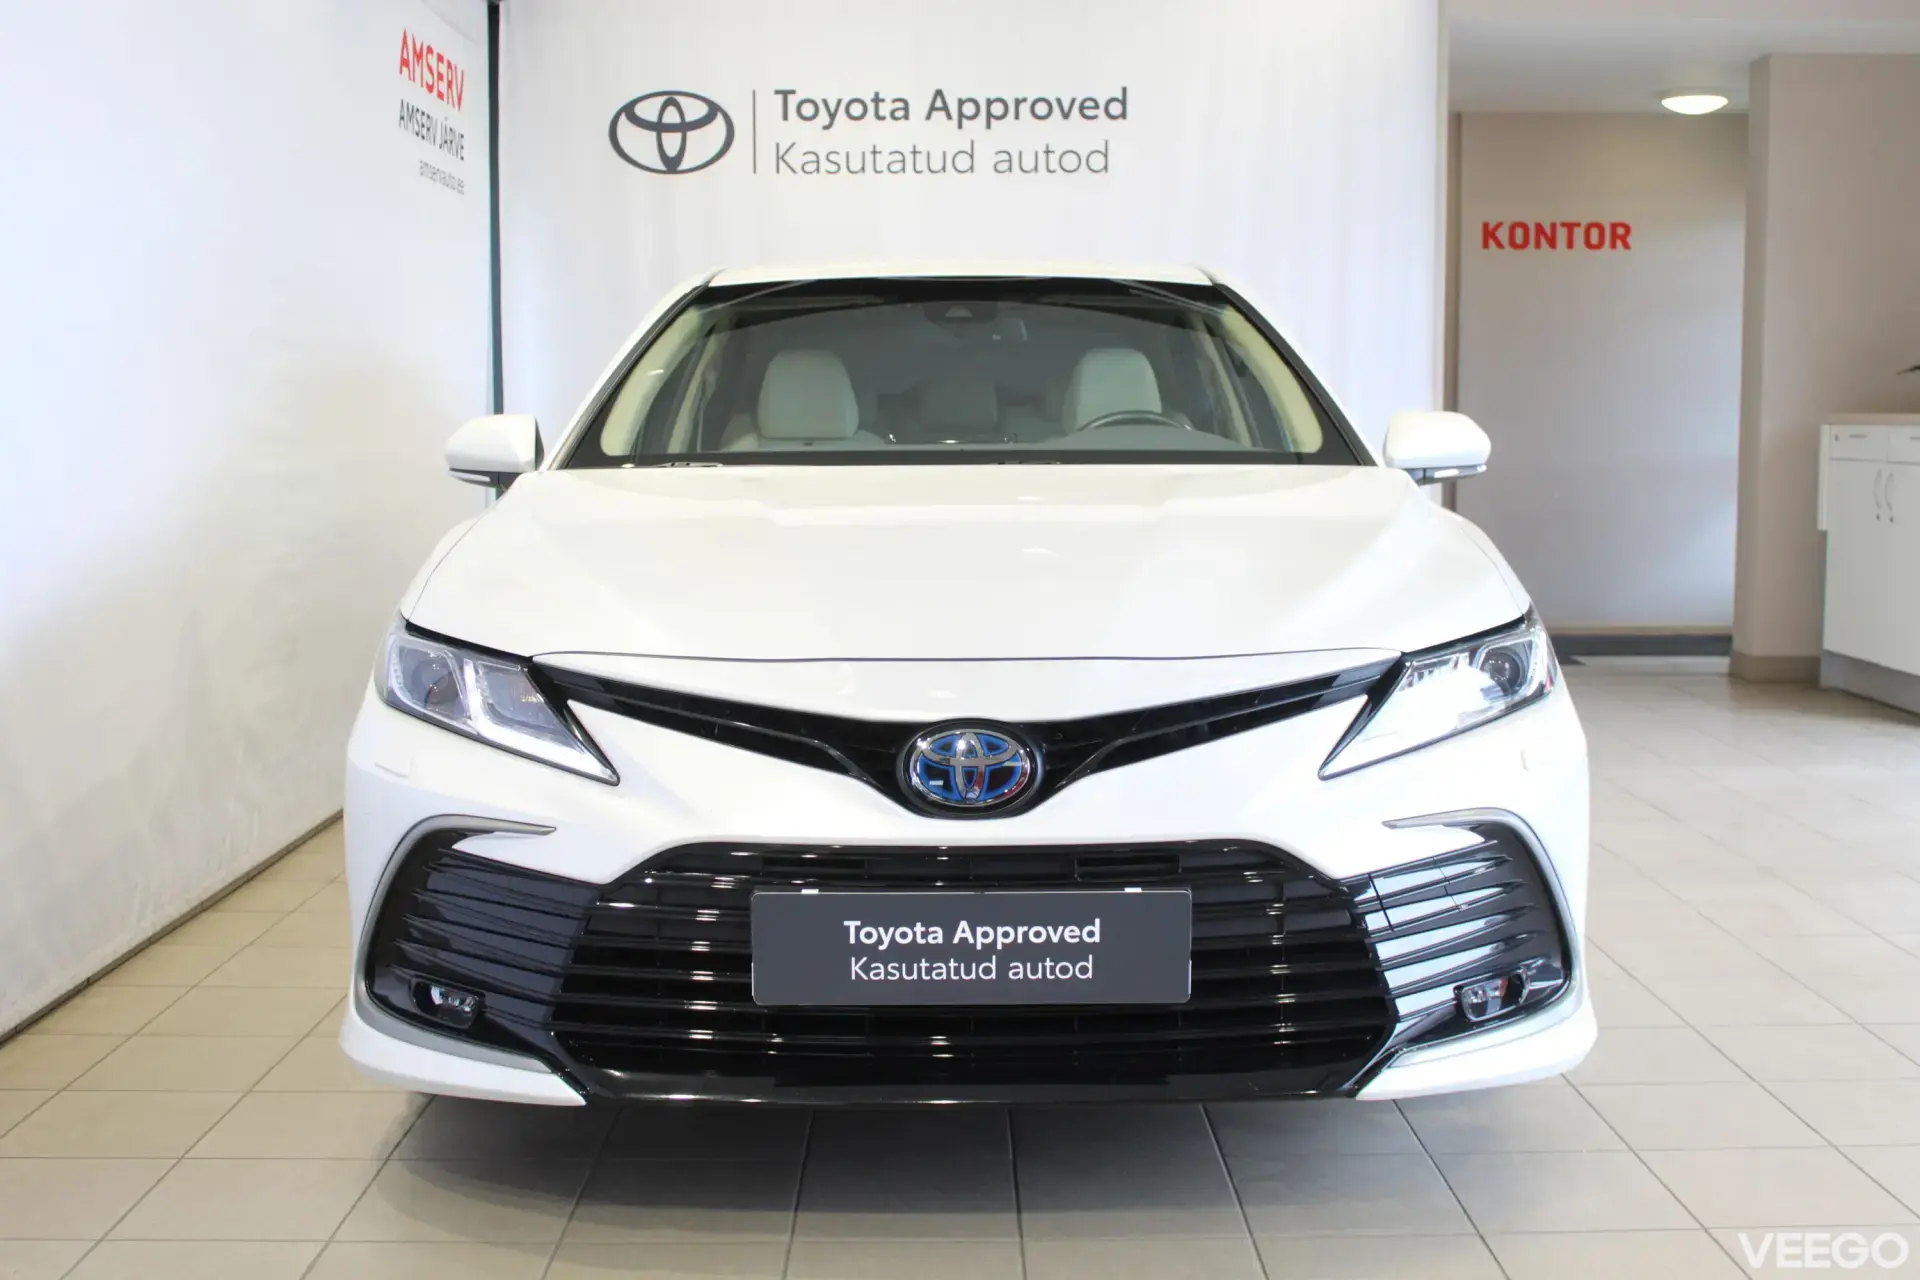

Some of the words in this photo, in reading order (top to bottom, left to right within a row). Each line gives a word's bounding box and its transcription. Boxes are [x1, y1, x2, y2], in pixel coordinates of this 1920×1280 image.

[399, 27, 465, 112] AMSERV
[398, 98, 438, 148] AMSERV
[773, 88, 911, 130] Toyota
[924, 86, 1129, 130] Approved
[773, 139, 976, 175] Kasutatud
[991, 139, 1111, 175] autod
[1481, 220, 1633, 251] KONTOR
[843, 920, 944, 951] Toyota
[952, 918, 1101, 950] Approved
[850, 955, 998, 981] Kasutatud
[1008, 954, 1094, 981] autod
